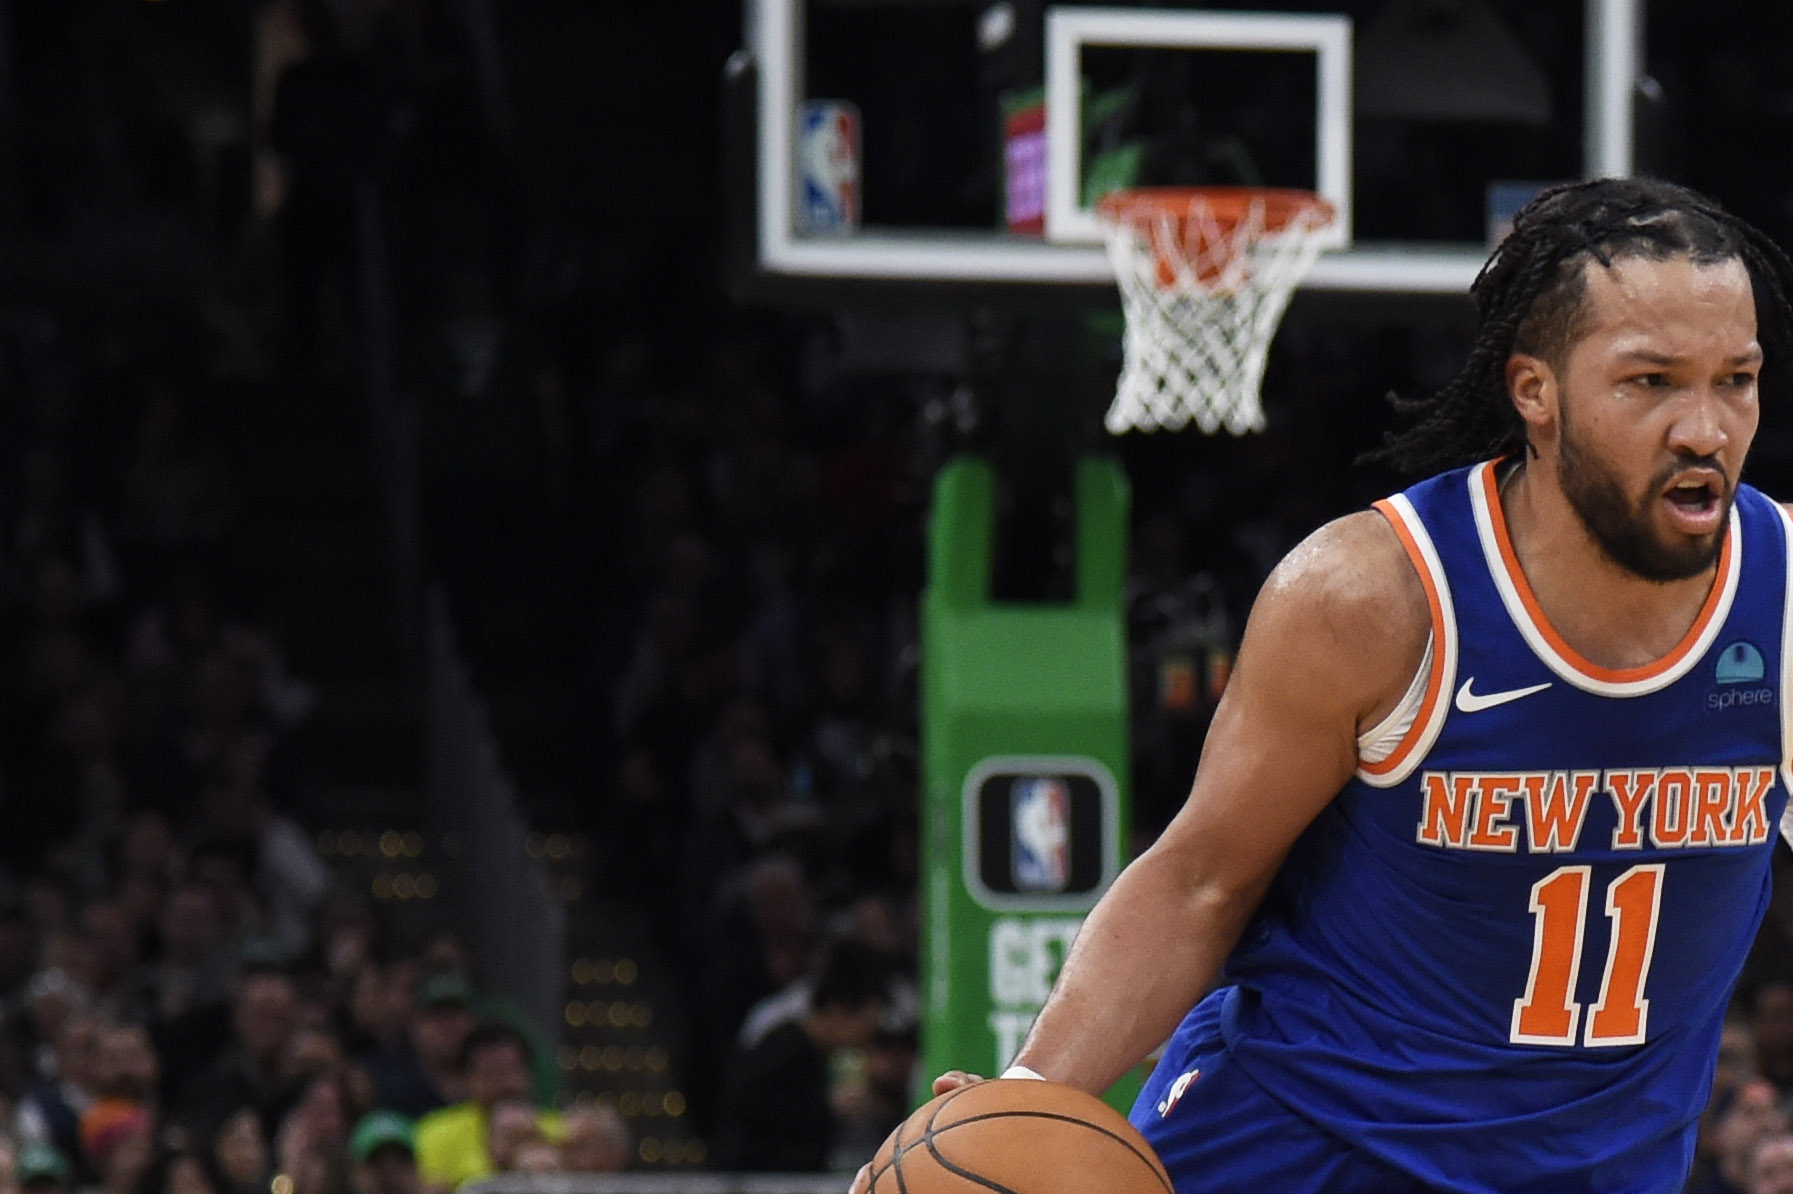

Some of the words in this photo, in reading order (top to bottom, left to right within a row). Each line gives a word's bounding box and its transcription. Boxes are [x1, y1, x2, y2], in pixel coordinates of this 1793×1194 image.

[1708, 688, 1773, 711] sphere
[1417, 768, 1601, 854] NEW
[1602, 765, 1776, 849] YORK
[1509, 862, 1666, 1048] 11
